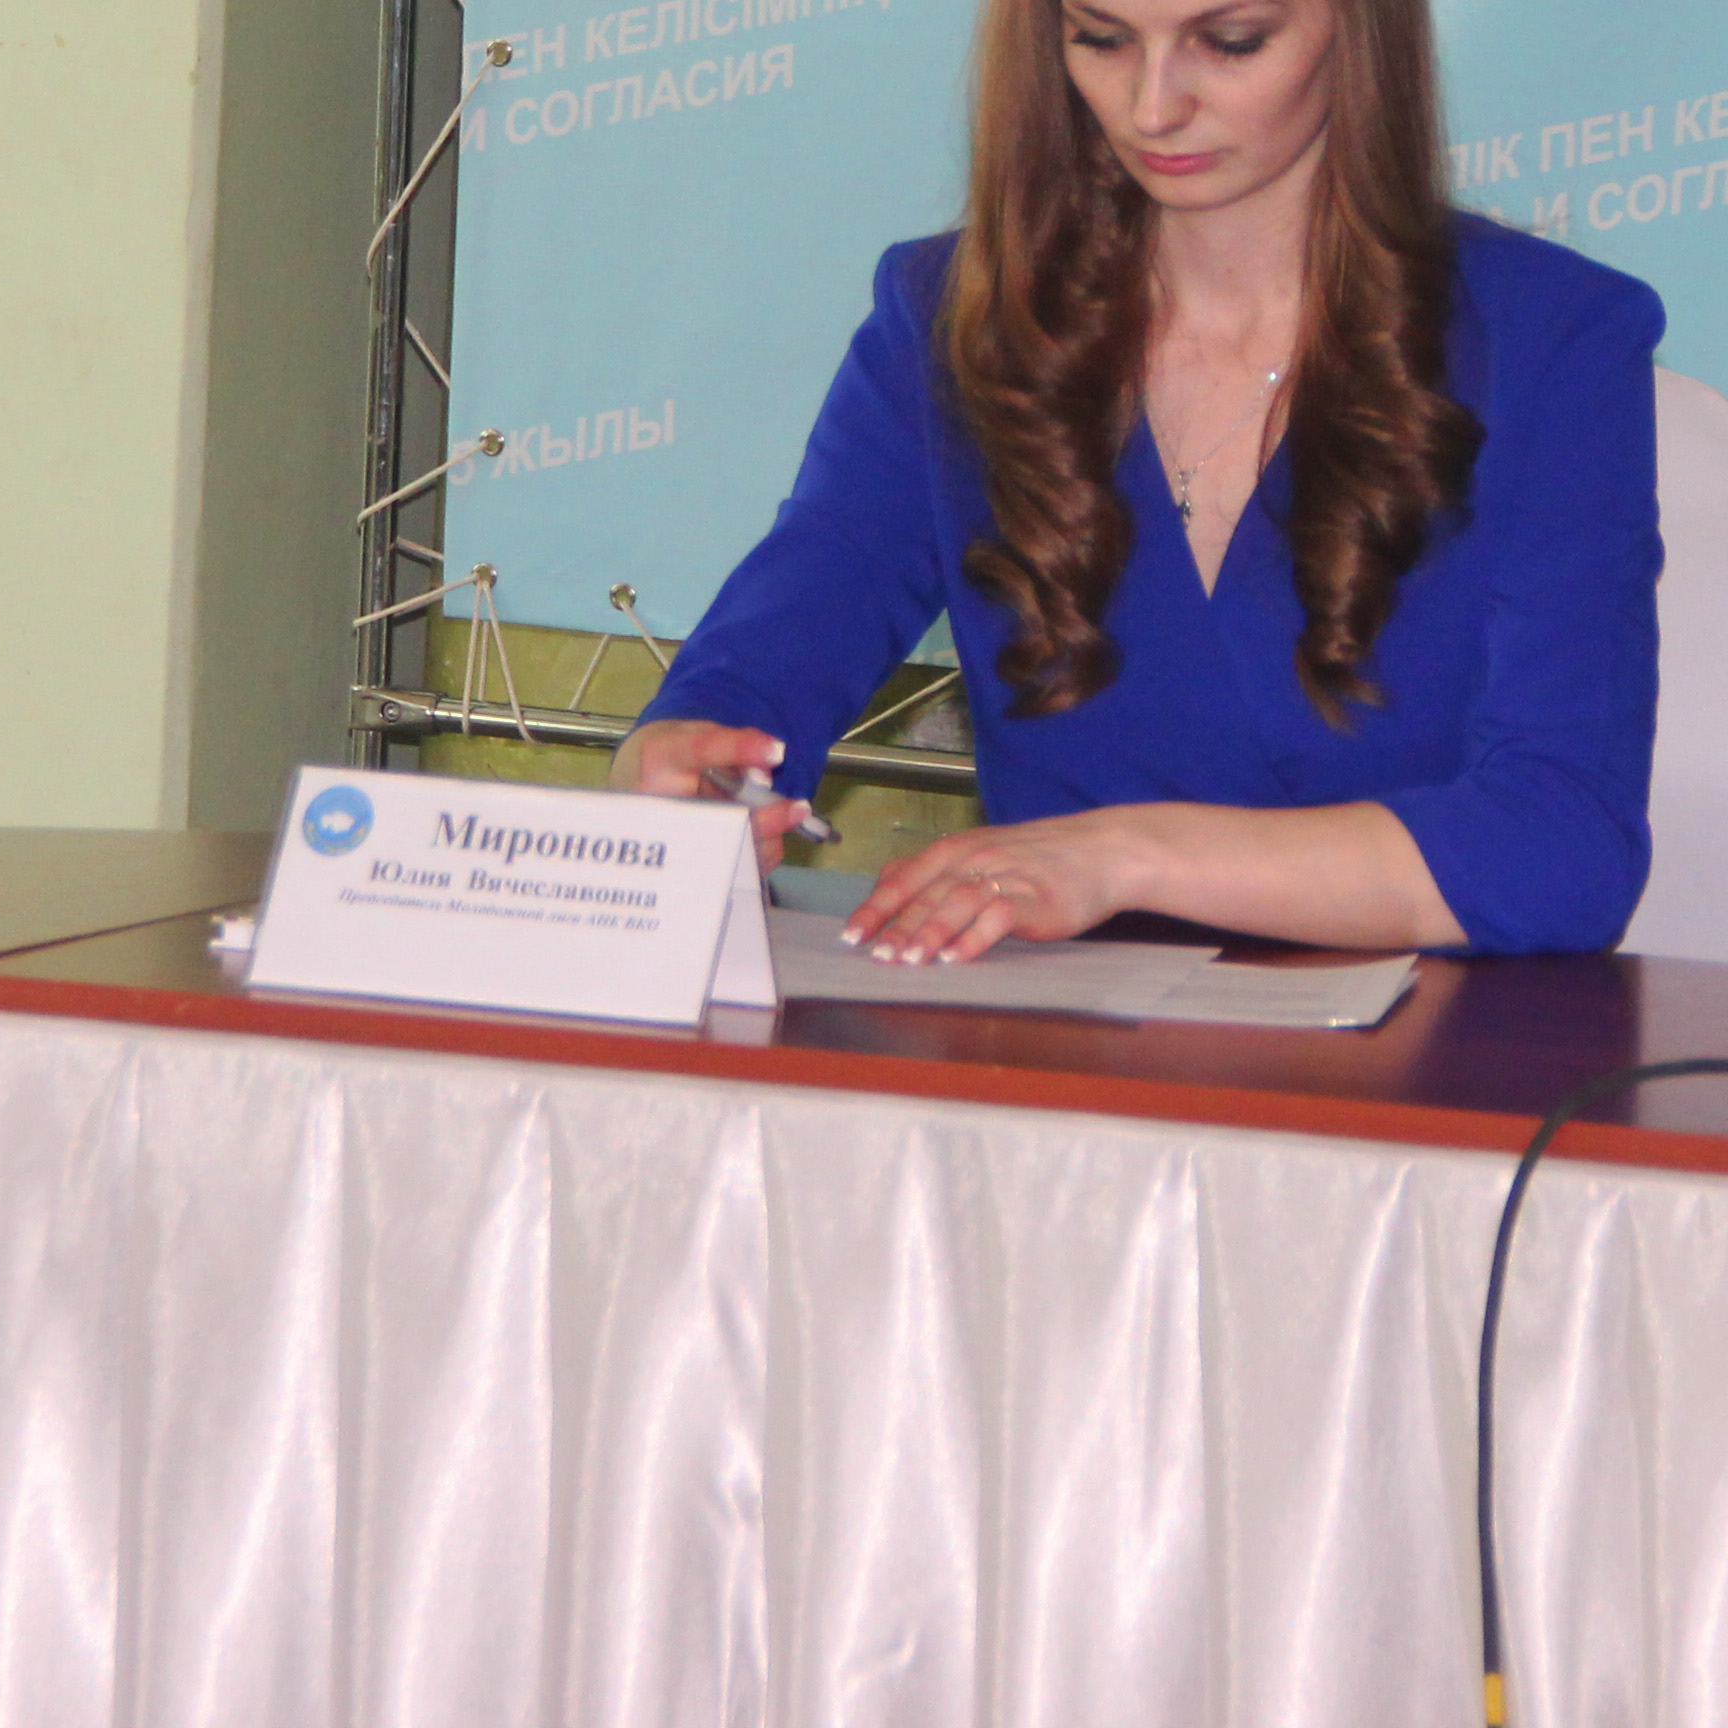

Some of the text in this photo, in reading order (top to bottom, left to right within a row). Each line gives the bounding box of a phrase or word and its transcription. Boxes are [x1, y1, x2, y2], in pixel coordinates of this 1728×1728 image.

[507, 43, 796, 143] СОГЛАСИЯ
[1539, 104, 1657, 173] ПЕН
[1529, 191, 1571, 239] И
[493, 398, 677, 478] ЖЫЛЫ
[431, 810, 668, 866] Миронова
[369, 859, 659, 909] Юлия Вячеславовна
